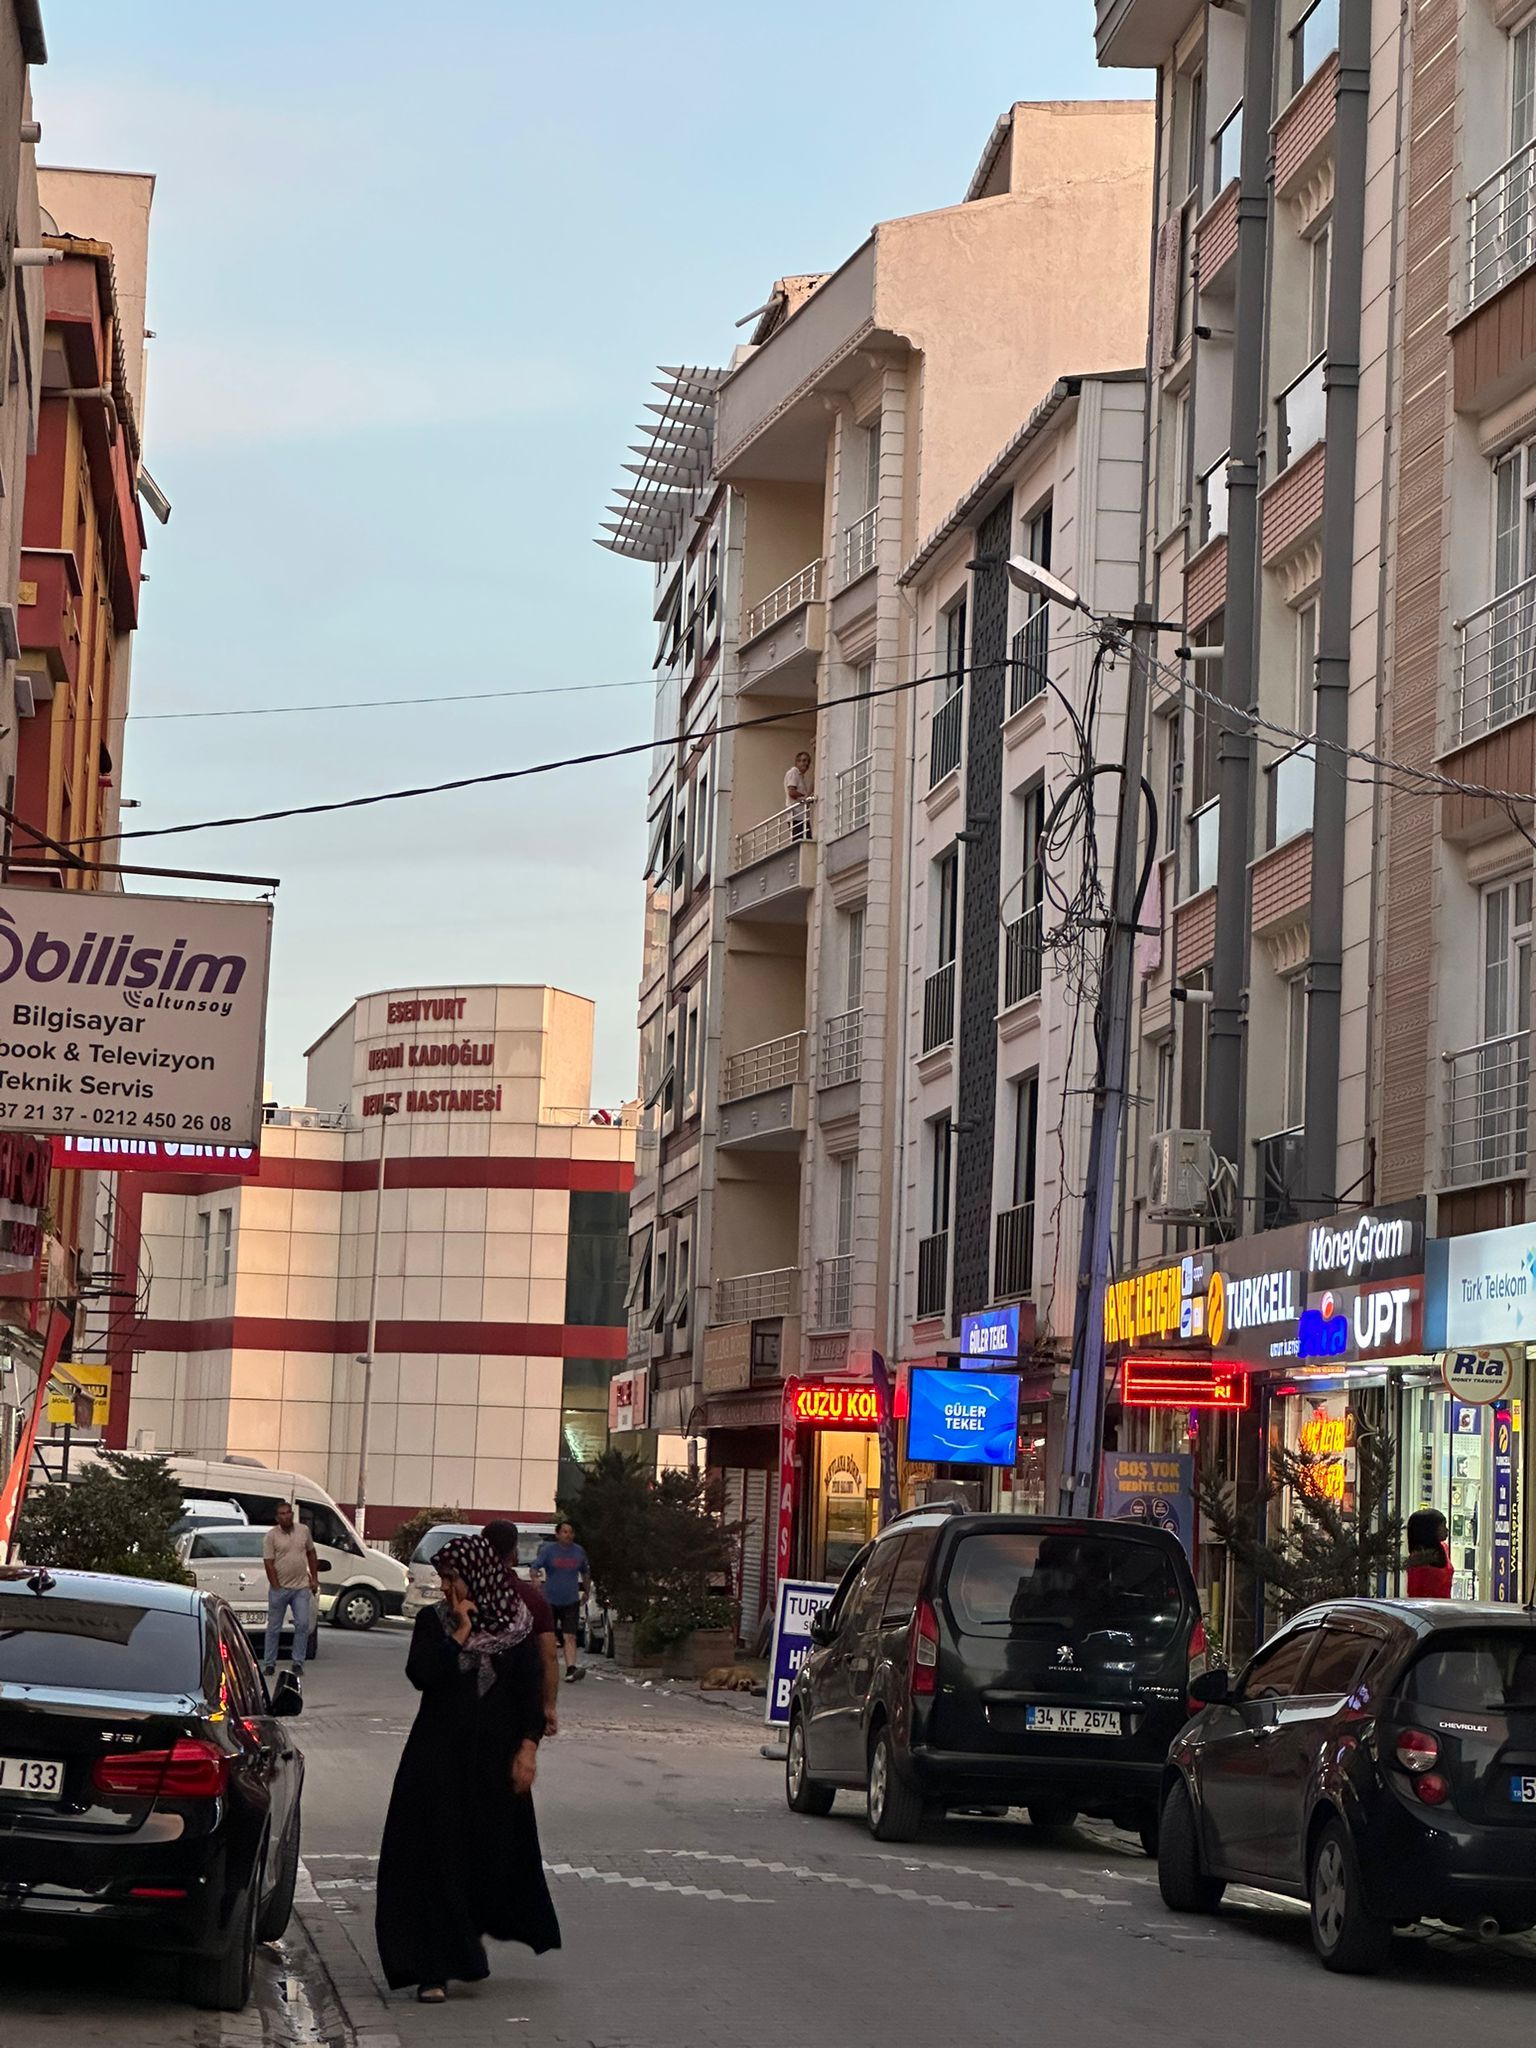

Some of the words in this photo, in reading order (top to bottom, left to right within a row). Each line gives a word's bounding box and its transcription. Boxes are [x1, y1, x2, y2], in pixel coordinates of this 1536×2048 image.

[25, 931, 247, 994] bilisim
[143, 992, 233, 1016] altunsoy
[387, 998, 467, 1024] ESENYURT
[13, 1004, 146, 1036] Bilgisayar
[64, 1042, 80, 1061] &
[89, 1044, 215, 1072] Televizyon
[368, 1042, 404, 1071] NECMİ
[408, 1039, 495, 1067] KADIOĞLU
[0, 1070, 72, 1093] Teknik
[80, 1075, 154, 1099] Servis
[406, 1084, 502, 1112] HASTANESİ
[24, 1104, 44, 1120] 21
[52, 1106, 75, 1121] 37
[93, 1108, 136, 1126] 0212
[143, 1111, 176, 1128] 450
[182, 1114, 204, 1130] 26
[210, 1115, 232, 1132] 08
[1310, 1215, 1403, 1277] MoneyGram
[1226, 1270, 1295, 1330] TURKCELL
[1462, 1277, 1483, 1303] Türk
[1486, 1273, 1527, 1300] Telekom
[1354, 1288, 1410, 1349] UPT
[969, 1324, 989, 1354] GÜLER
[989, 1324, 1008, 1351] TEKEL
[1453, 1351, 1504, 1376] Ria
[797, 1391, 843, 1417] KUZU
[944, 1402, 987, 1417] GÜLER
[945, 1418, 985, 1431] TEKEL
[1119, 1461, 1147, 1479] BOŞ
[1151, 1462, 1180, 1478] YOK
[1037, 1709, 1053, 1725] 34
[1060, 1709, 1077, 1726] KF
[1084, 1711, 1116, 1729] 2674
[1439, 1721, 1488, 1732] CHEVROLET
[20, 1762, 57, 1790] 133
[1522, 1778, 1536, 1801] 5
